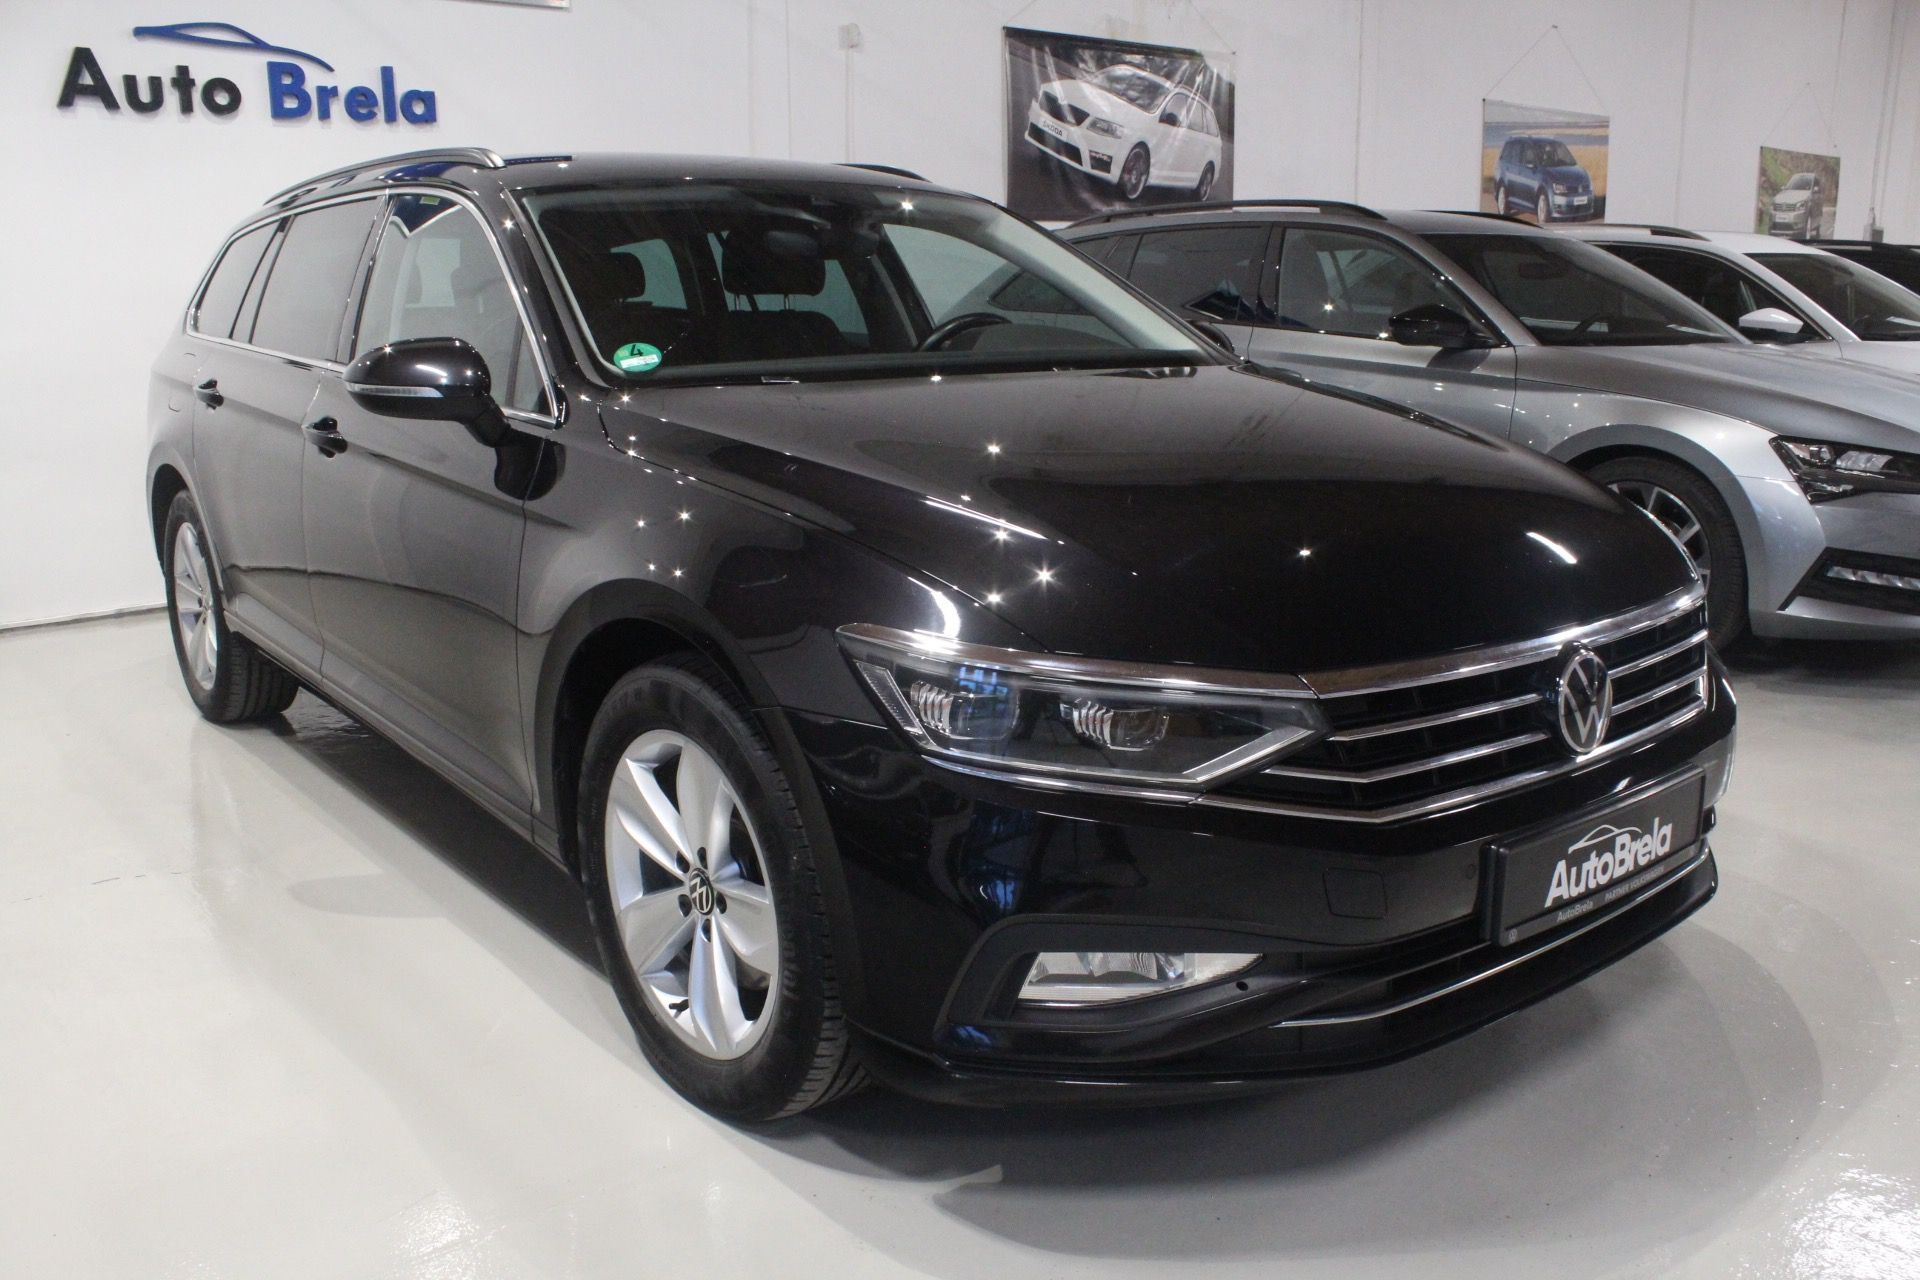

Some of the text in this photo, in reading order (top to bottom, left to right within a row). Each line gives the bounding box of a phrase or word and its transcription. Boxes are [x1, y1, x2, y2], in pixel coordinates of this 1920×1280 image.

[56, 46, 437, 125] Auto Brela
[630, 343, 644, 357] 4
[1544, 816, 1673, 908] AutoBrela
